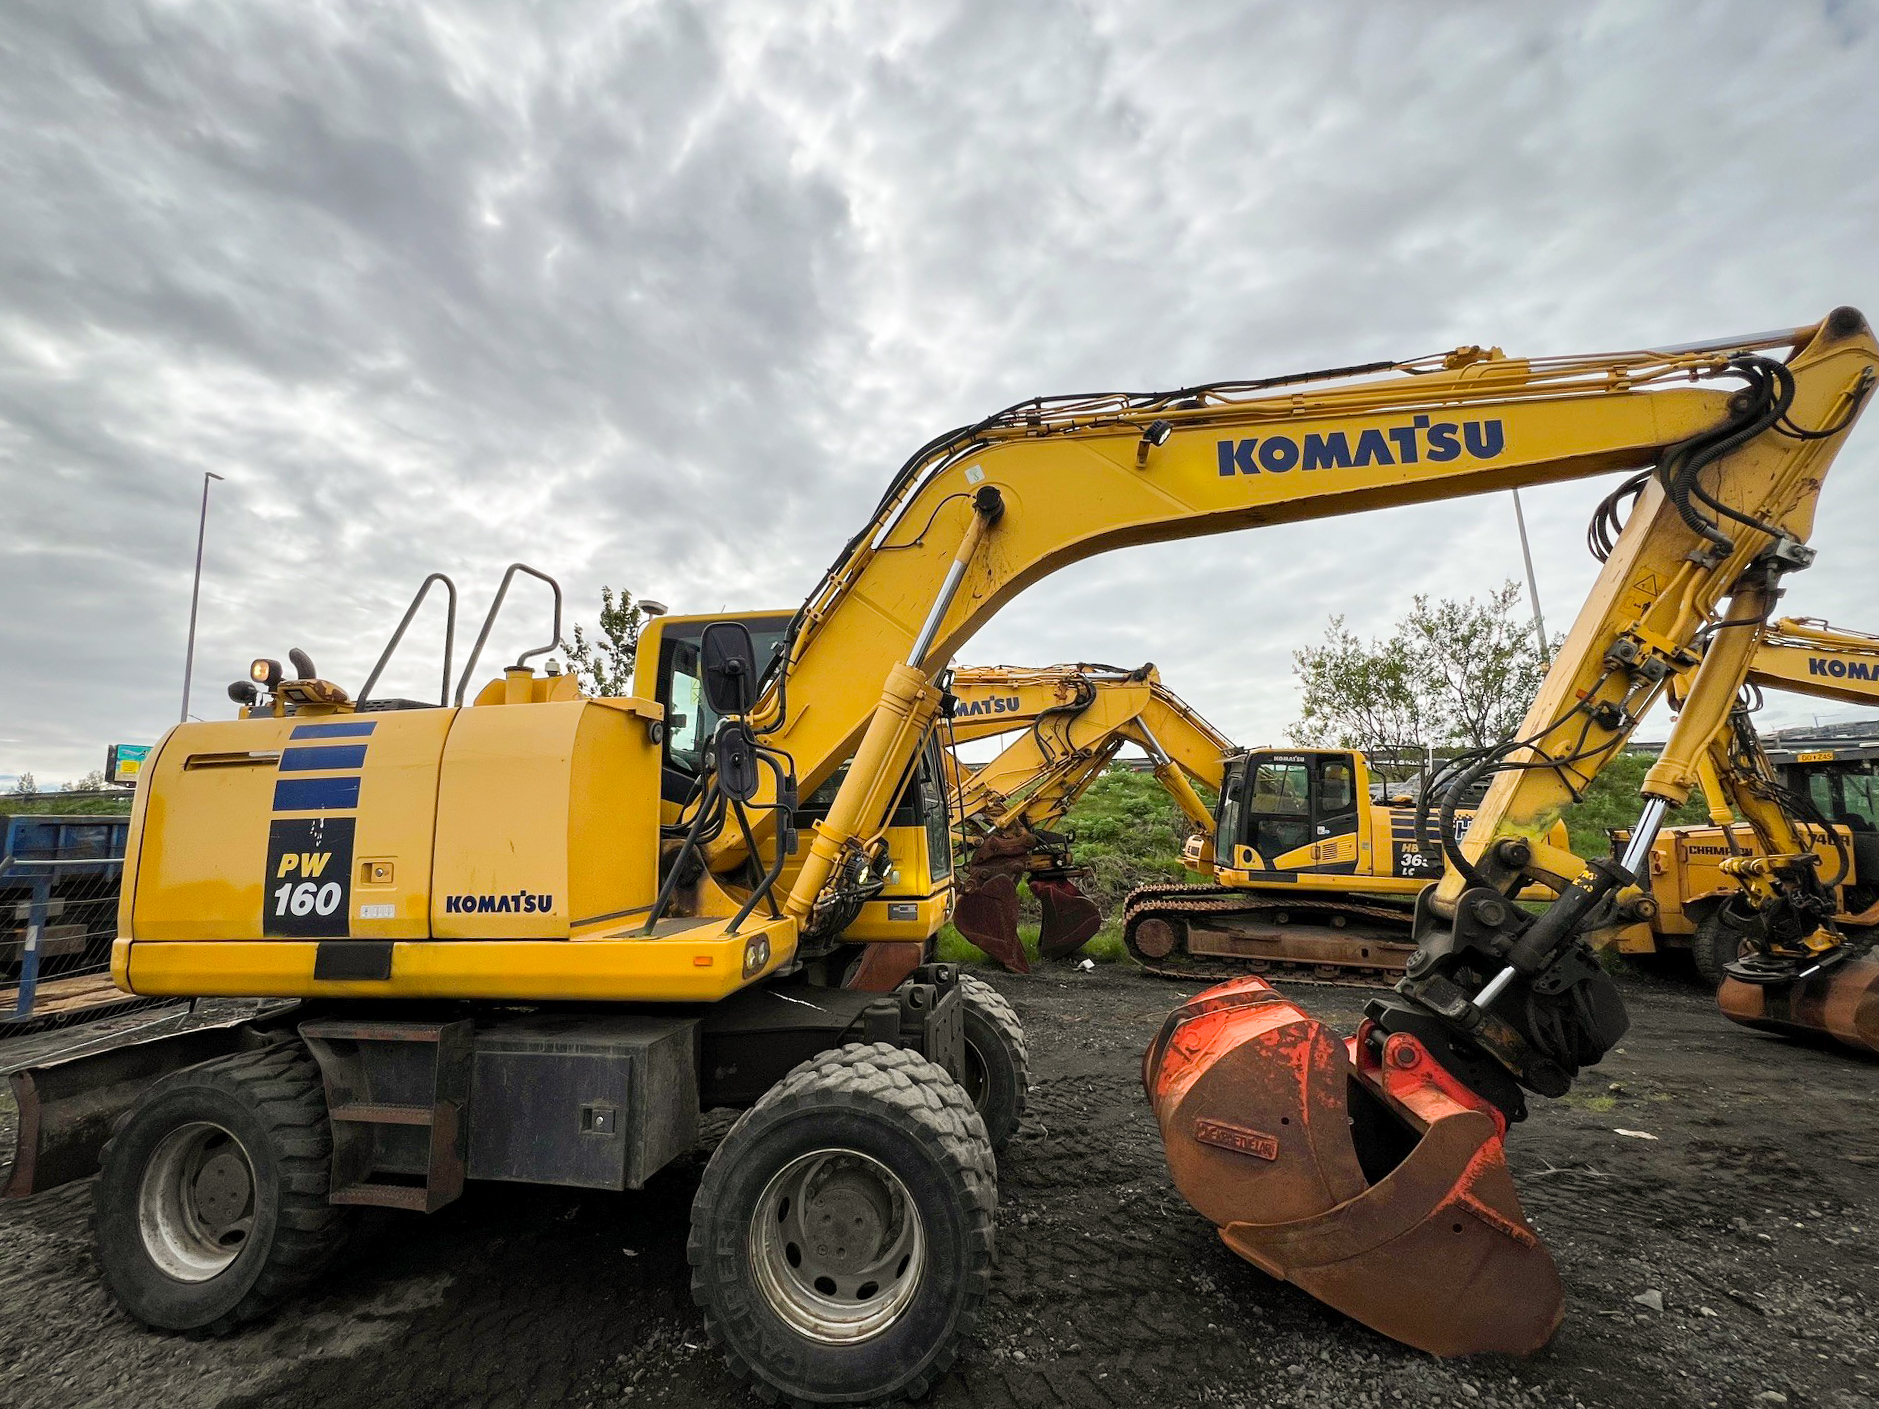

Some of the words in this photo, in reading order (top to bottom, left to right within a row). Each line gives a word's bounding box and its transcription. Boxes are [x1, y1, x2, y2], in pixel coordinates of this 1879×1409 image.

[1217, 414, 1504, 476] KOMATSU
[1401, 843, 1419, 853] HB
[277, 852, 332, 878] PW
[1402, 867, 1415, 876] LC
[274, 882, 342, 916] 160
[446, 890, 553, 913] KOMATSU
